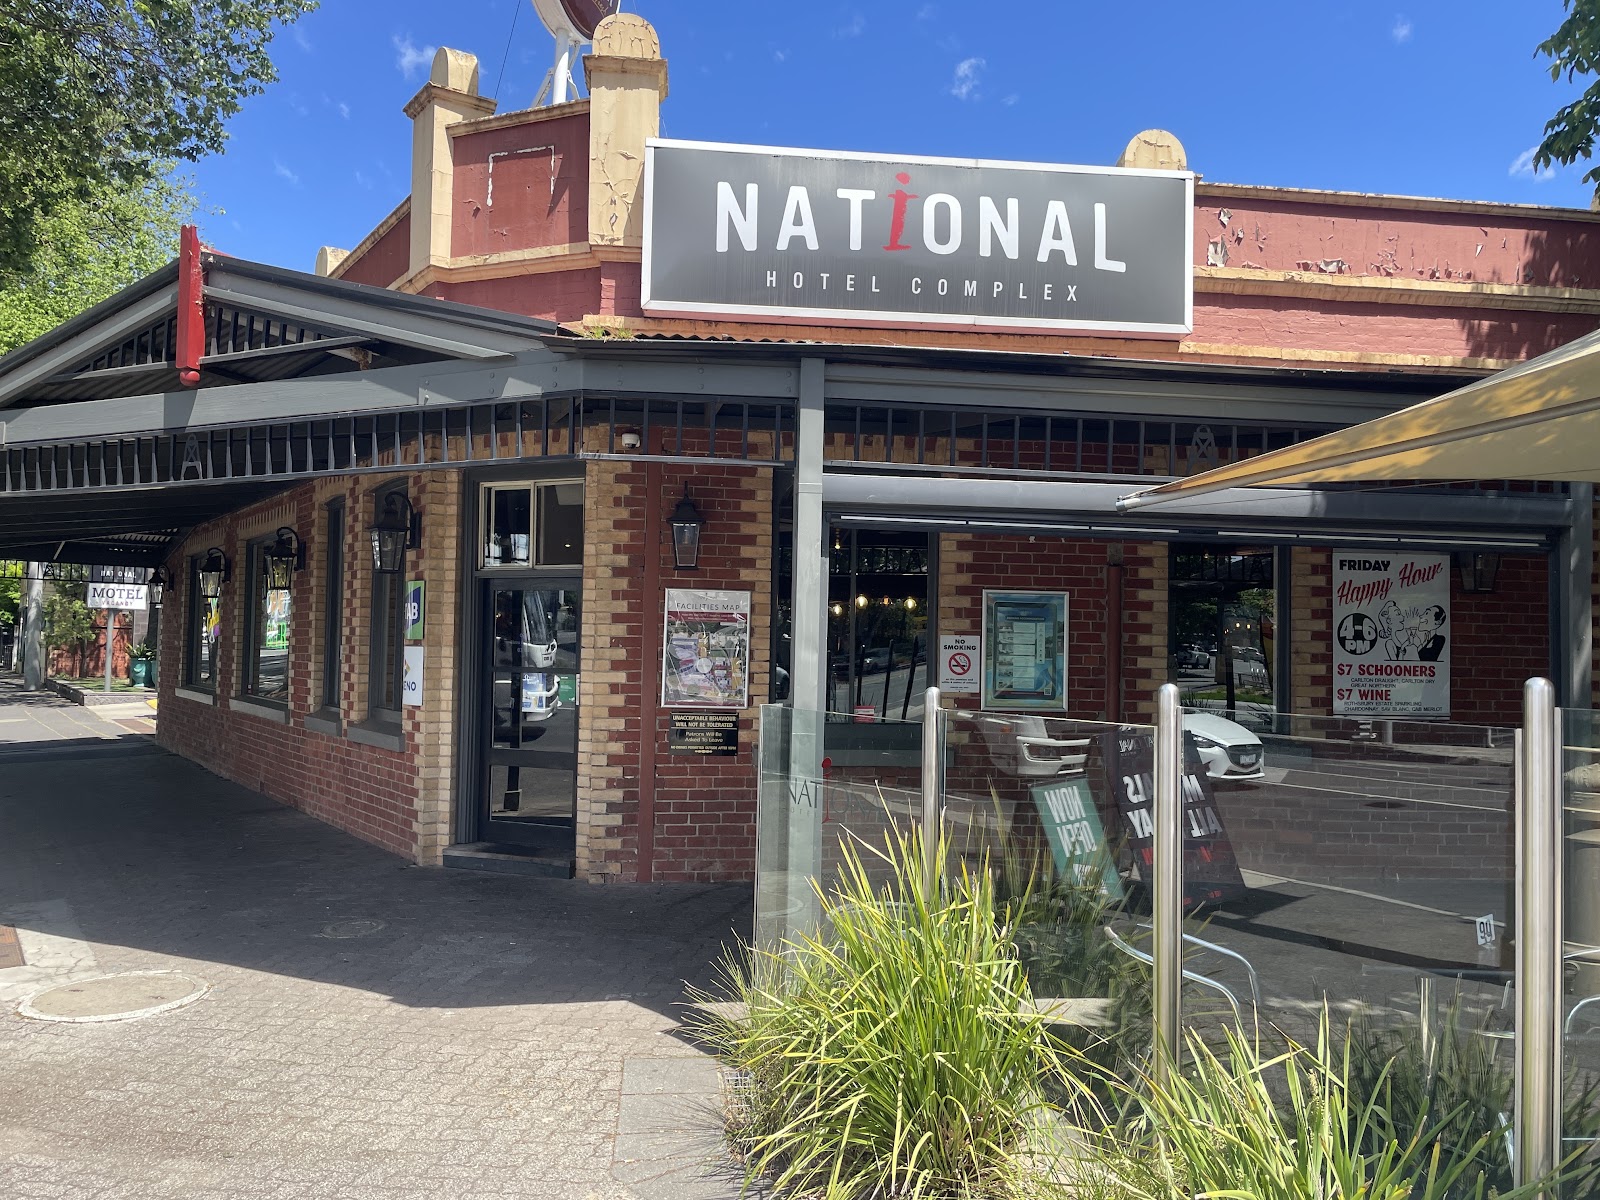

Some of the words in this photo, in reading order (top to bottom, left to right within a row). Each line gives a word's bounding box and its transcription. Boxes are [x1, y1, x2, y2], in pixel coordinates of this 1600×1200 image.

[766, 270, 880, 293] HOTEL
[911, 277, 1078, 302] COMPLEX
[1339, 560, 1391, 572] FRIDAY
[1337, 577, 1393, 609] Happy
[1398, 561, 1443, 589] Hour
[92, 587, 143, 600] MOTEL
[676, 603, 719, 611] FACILITIES
[1340, 614, 1377, 640] 4-6
[1345, 639, 1371, 654] PM
[1337, 663, 1353, 676] $7
[1358, 664, 1436, 677] SCHOONERS
[403, 681, 417, 691] ENO
[1337, 688, 1353, 701] $7
[1358, 689, 1391, 701] WINE
